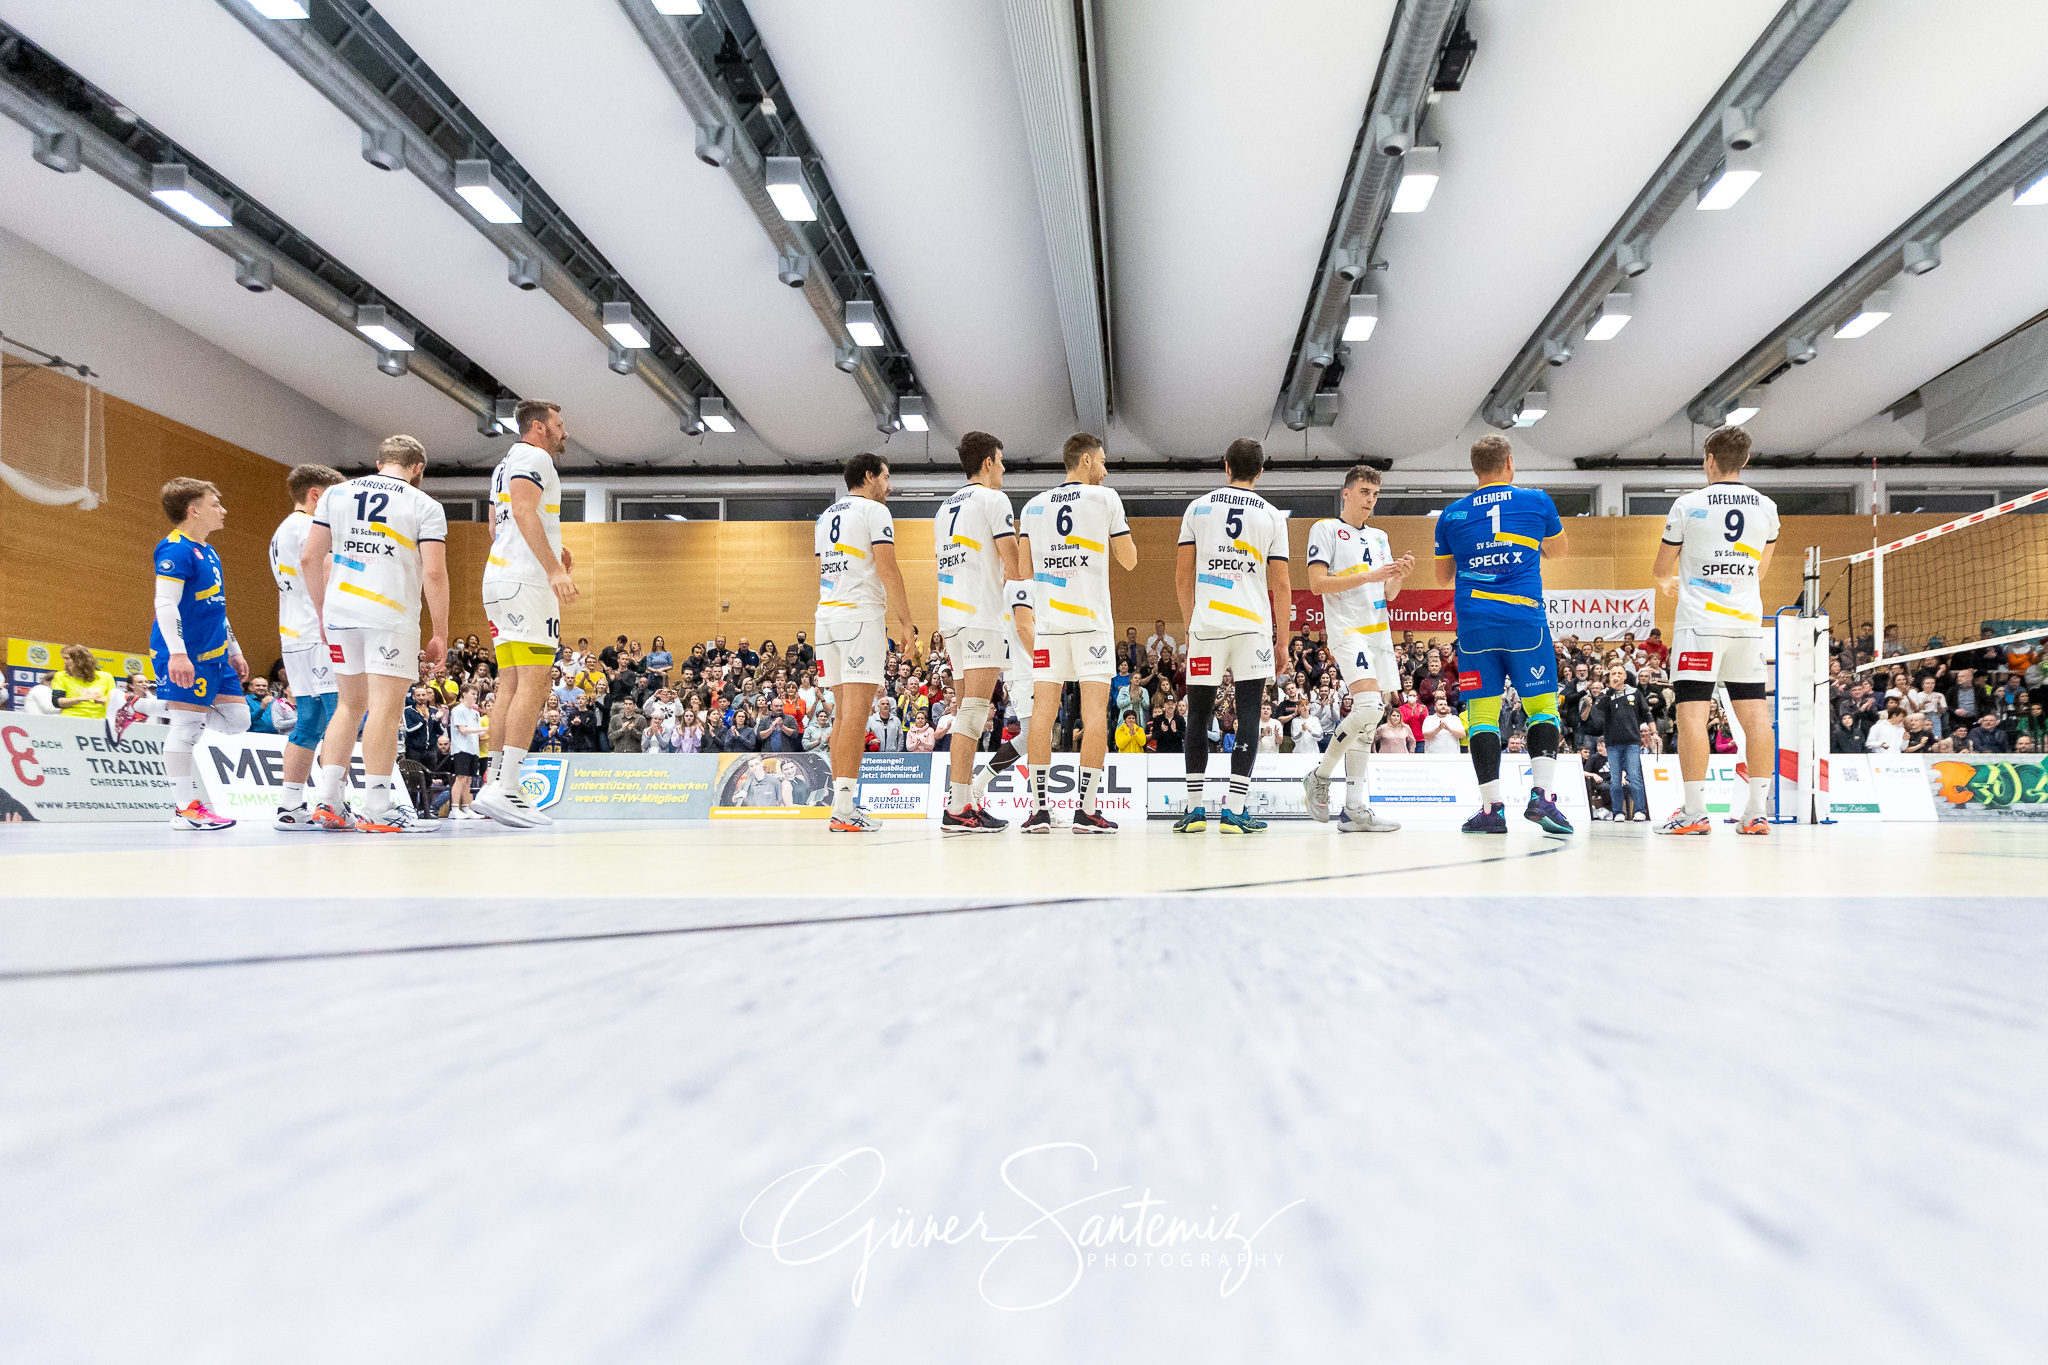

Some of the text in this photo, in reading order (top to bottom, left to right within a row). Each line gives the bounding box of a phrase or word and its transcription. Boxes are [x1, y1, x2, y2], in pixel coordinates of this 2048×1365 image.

[1210, 493, 1265, 509] BIBELRIETHER
[1473, 491, 1513, 506] KLEMENT
[1707, 493, 1760, 506] TAFELMAYER
[353, 491, 390, 523] 12
[948, 505, 961, 537] 7
[1056, 505, 1073, 536] 6
[1225, 507, 1244, 539] 5
[1486, 504, 1501, 534] 1
[1723, 509, 1745, 542] 9
[829, 515, 841, 543] 8
[344, 541, 381, 554] SPECK
[1218, 545, 1226, 553] SV
[1476, 540, 1513, 550] SV Schwaig
[1362, 547, 1372, 566] 4
[1469, 552, 1509, 569] SPECK
[1724, 550, 1749, 558] Schwaig
[821, 562, 842, 574] SPECK
[939, 554, 960, 569] SPECK
[1043, 556, 1077, 569] SPECK
[1208, 559, 1244, 572] SPECK
[212, 566, 222, 586] 3
[1702, 564, 1746, 576] SPECK
[1543, 598, 1650, 614] RTNANKA
[546, 617, 560, 639] 10
[1356, 652, 1369, 670] 4
[194, 677, 207, 697] 3
[861, 757, 905, 765] äftemangel?
[573, 768, 670, 780] Vereint anpacken,
[859, 765, 920, 773] rbundausbildung!
[90, 778, 148, 788] CHRISTIAN
[569, 780, 709, 791] unterstützen, netzwerken
[227, 793, 283, 807] ZIMME
[574, 793, 609, 803] werde
[611, 793, 690, 805] FNW-Mitglied!
[1013, 797, 1130, 809] Webetehnik
